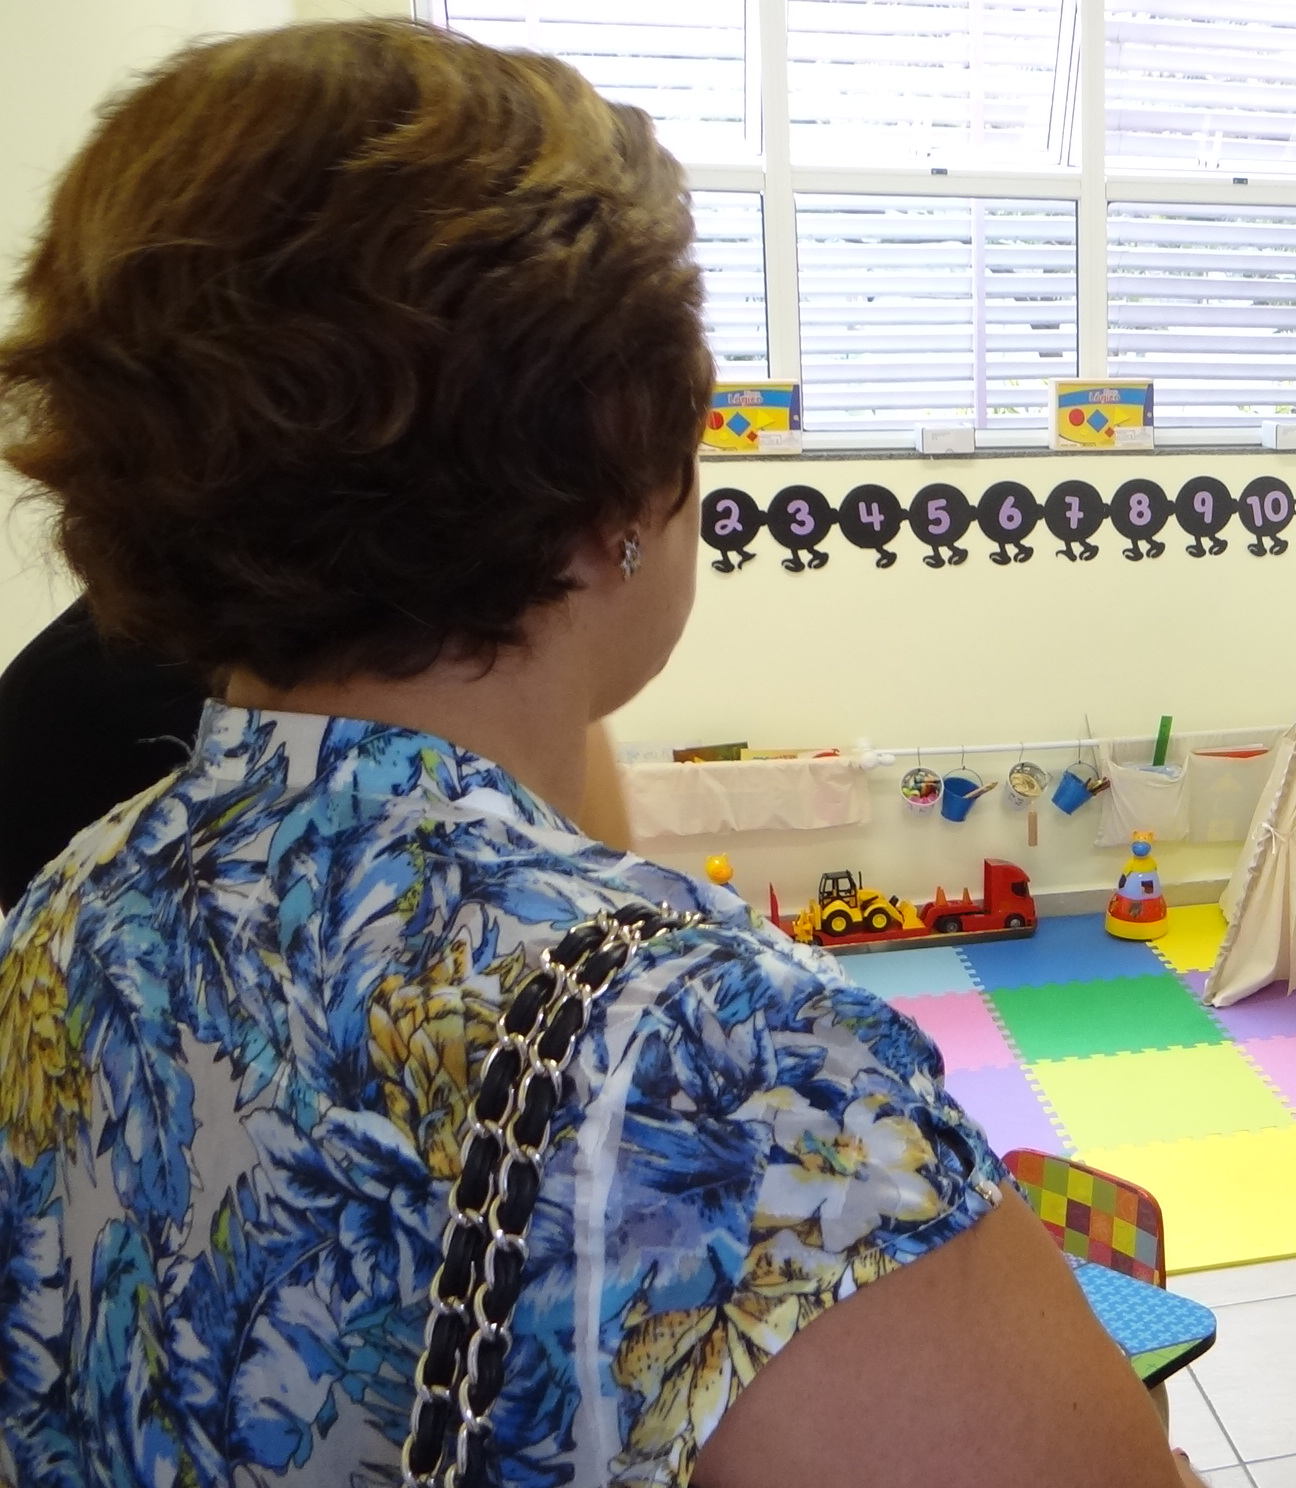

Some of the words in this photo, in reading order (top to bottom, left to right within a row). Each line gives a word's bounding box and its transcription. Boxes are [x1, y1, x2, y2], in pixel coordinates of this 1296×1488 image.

[714, 499, 743, 536] 2
[786, 499, 815, 536] 3
[858, 501, 885, 531] 4
[927, 498, 951, 535] 5
[998, 495, 1022, 530] 6
[1064, 496, 1084, 529] 7
[1129, 492, 1152, 526] 8
[1193, 491, 1213, 524] 9
[1246, 490, 1289, 527] 10
